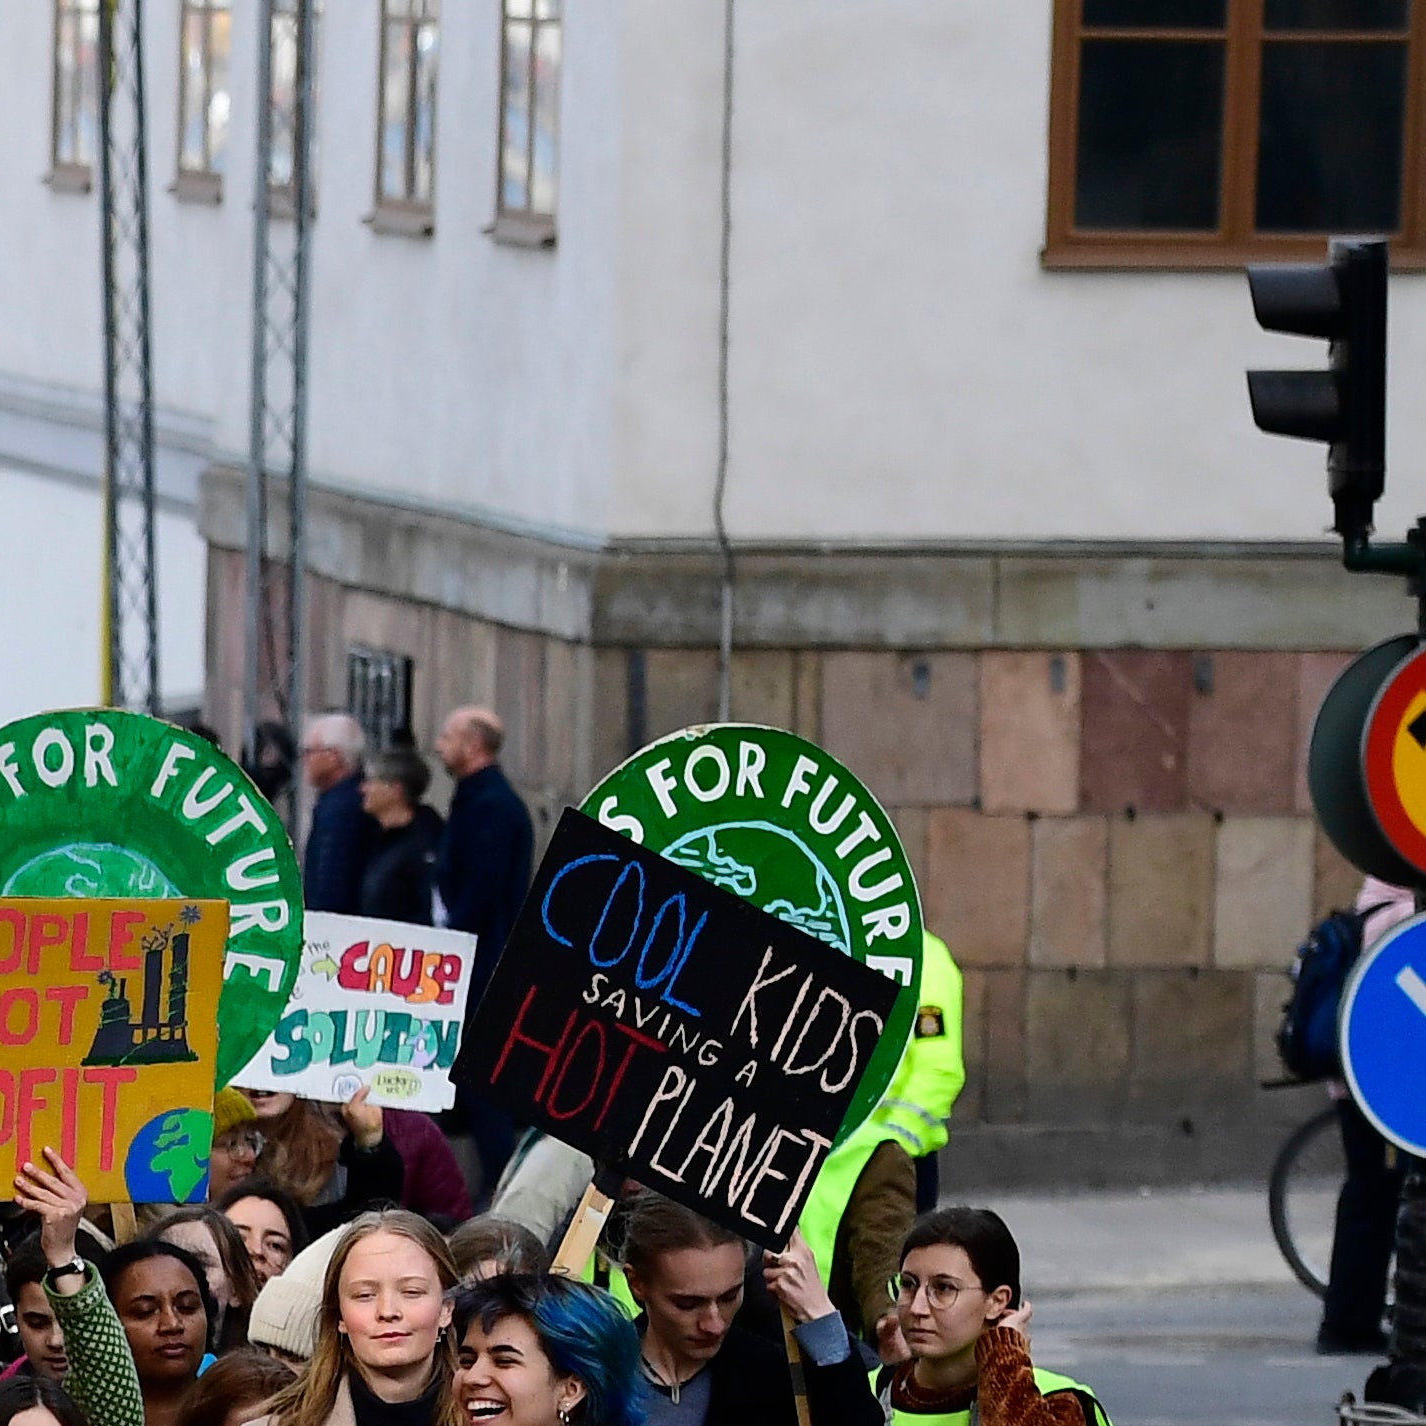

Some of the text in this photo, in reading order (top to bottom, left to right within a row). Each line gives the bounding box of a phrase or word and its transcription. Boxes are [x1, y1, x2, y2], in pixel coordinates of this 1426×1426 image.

[646, 740, 766, 818] FOR
[150, 741, 290, 994] FUTURE
[270, 1009, 460, 1077] SOLUTION
[542, 854, 884, 1095] COOL KIDS
[583, 973, 759, 1088] SAVING A
[490, 985, 668, 1132] HOT
[628, 1065, 833, 1235] PLANET
